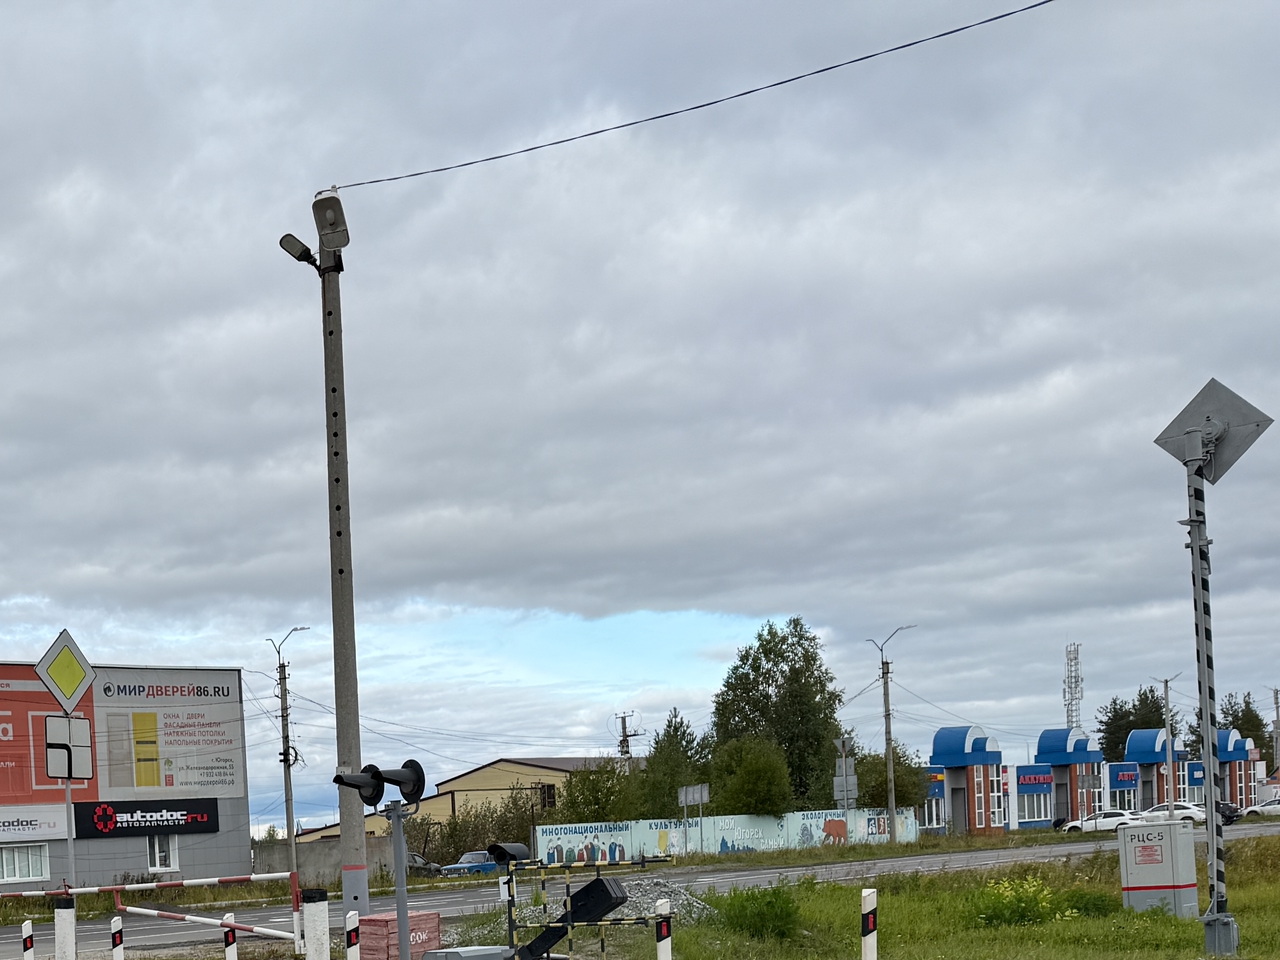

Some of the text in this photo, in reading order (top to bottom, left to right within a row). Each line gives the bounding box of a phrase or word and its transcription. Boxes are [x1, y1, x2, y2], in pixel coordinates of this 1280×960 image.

[116, 683, 230, 698] МИРДВЕРЕЙ86.RU
[801, 810, 846, 821] ЭКОЛОГИЧНЫЙ
[116, 820, 186, 828] АВТОЗАПЧАСТИ
[541, 821, 630, 837] МНОГОНАЦИОНАЛЬНЫЙ
[1130, 832, 1164, 843] РЦС-5
